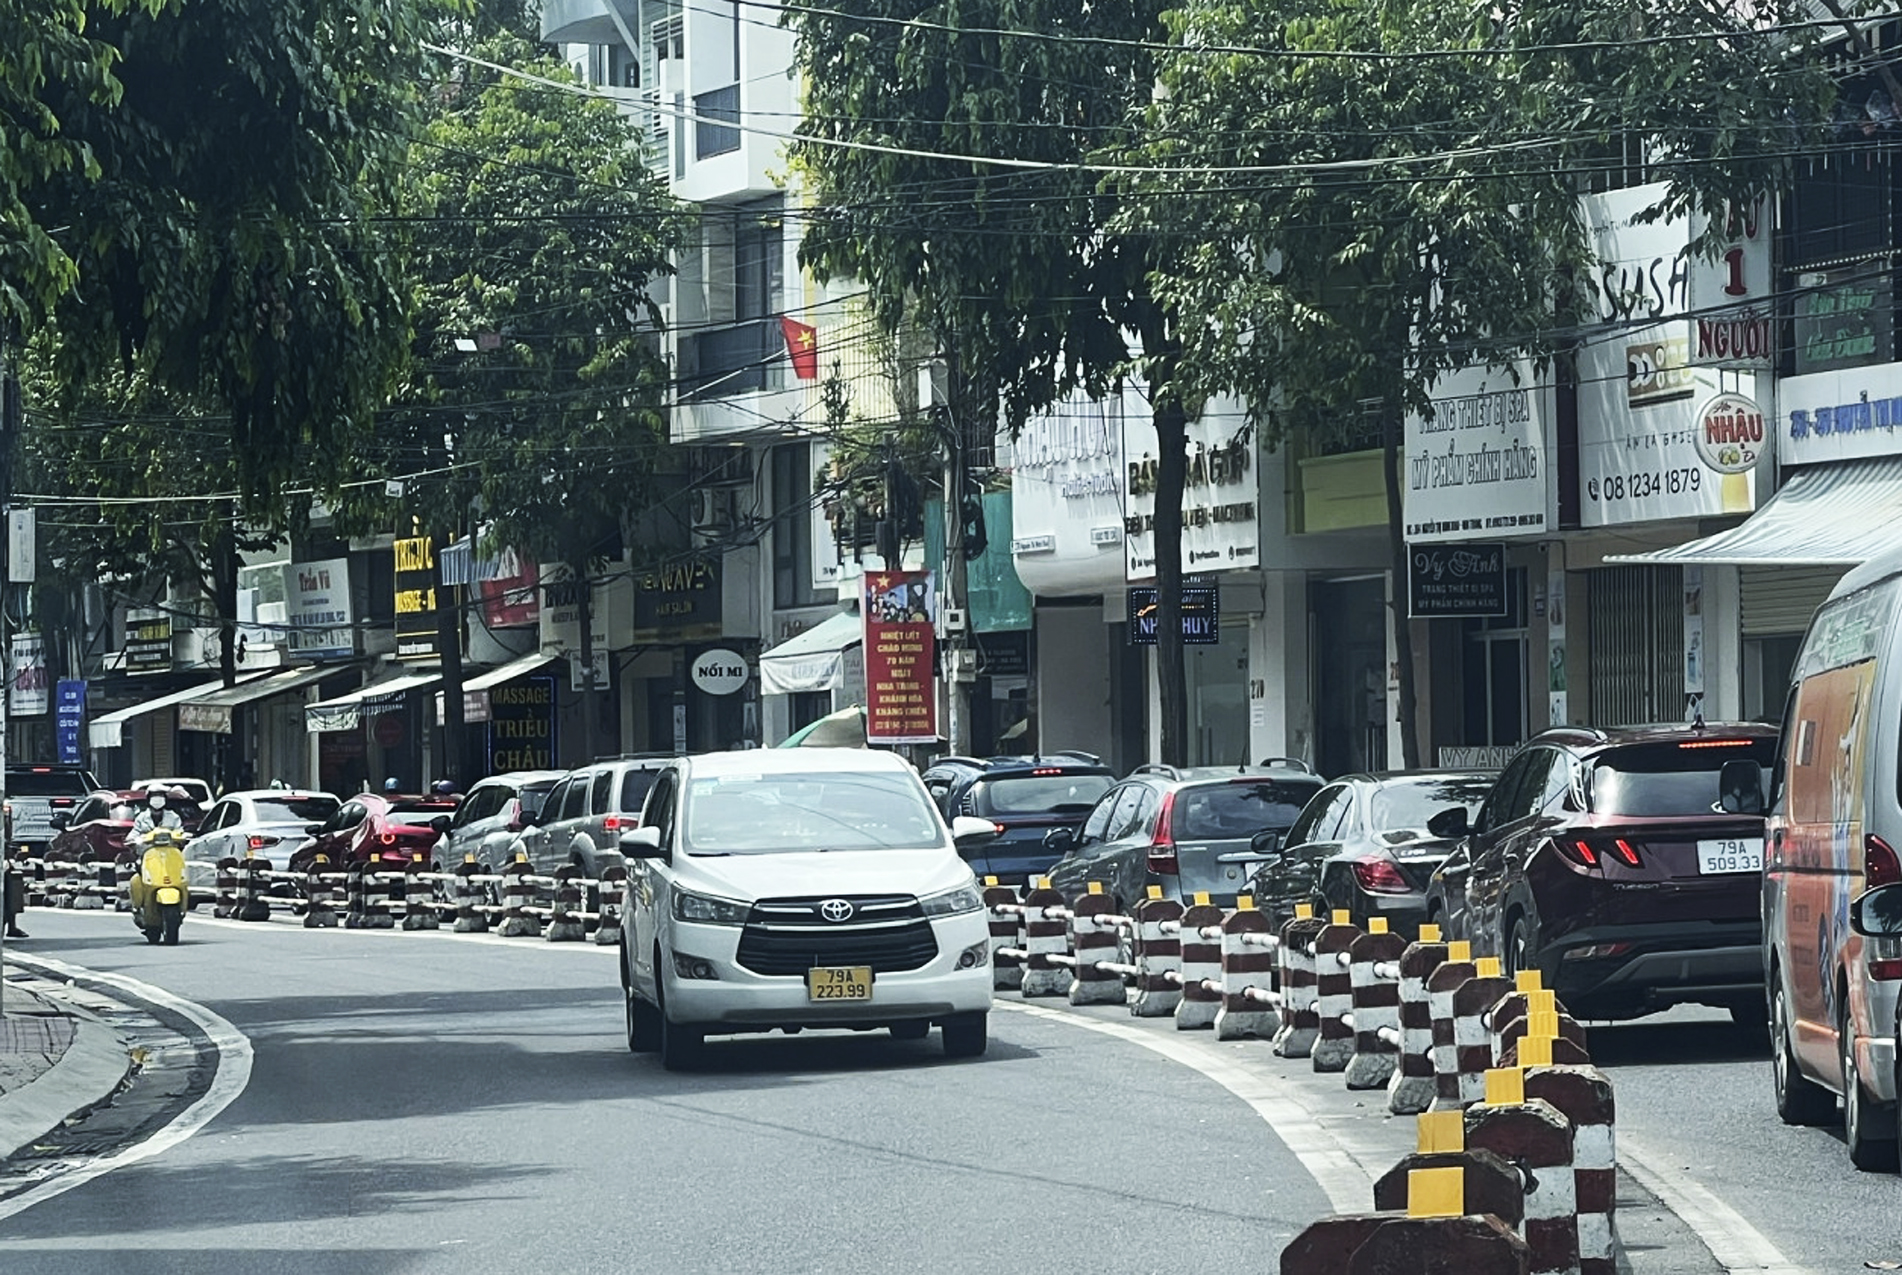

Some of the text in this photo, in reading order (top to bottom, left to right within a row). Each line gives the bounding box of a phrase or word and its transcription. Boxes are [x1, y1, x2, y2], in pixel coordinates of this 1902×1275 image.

[1723, 248, 1747, 296] 1
[1602, 256, 1688, 323] SUSH
[1705, 408, 1763, 450] NHẬU
[1603, 467, 1701, 501] 08 1234 1879
[1182, 616, 1211, 635] HUY
[698, 662, 742, 677] NỐI MI
[493, 687, 549, 704] MASSAGE
[495, 708, 548, 738] TRIỀU
[494, 744, 549, 769] CHÂU
[1442, 750, 1471, 768] VY
[1718, 841, 1747, 854] 79A
[1707, 855, 1760, 871] 509.33
[826, 970, 853, 983] 79A
[817, 984, 865, 998] 223.99
